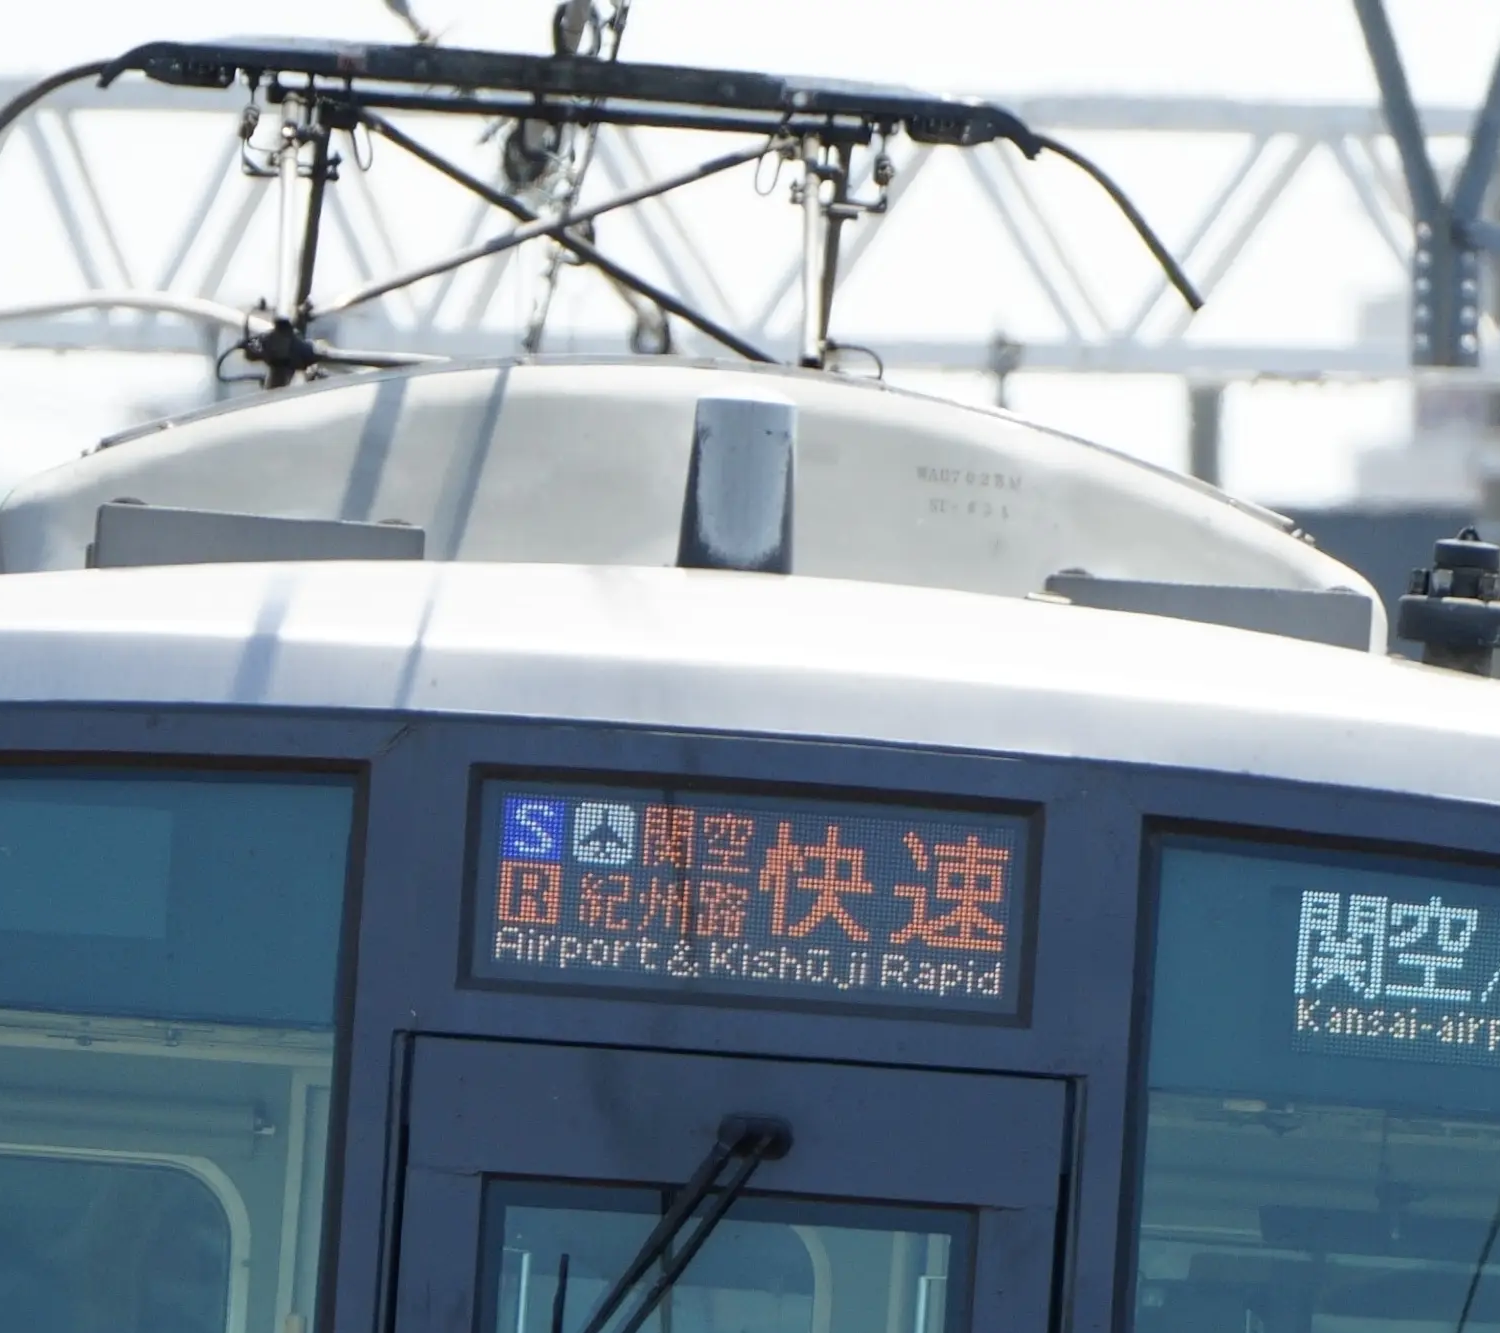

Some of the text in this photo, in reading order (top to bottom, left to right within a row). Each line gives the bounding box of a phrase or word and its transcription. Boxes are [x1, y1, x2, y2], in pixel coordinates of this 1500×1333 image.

[642, 804, 755, 875] 関空
[578, 868, 750, 938] 紀州路
[758, 820, 1011, 953] 快速
[495, 926, 659, 969] Airport
[666, 938, 700, 978] &
[880, 954, 1002, 998] Rapid
